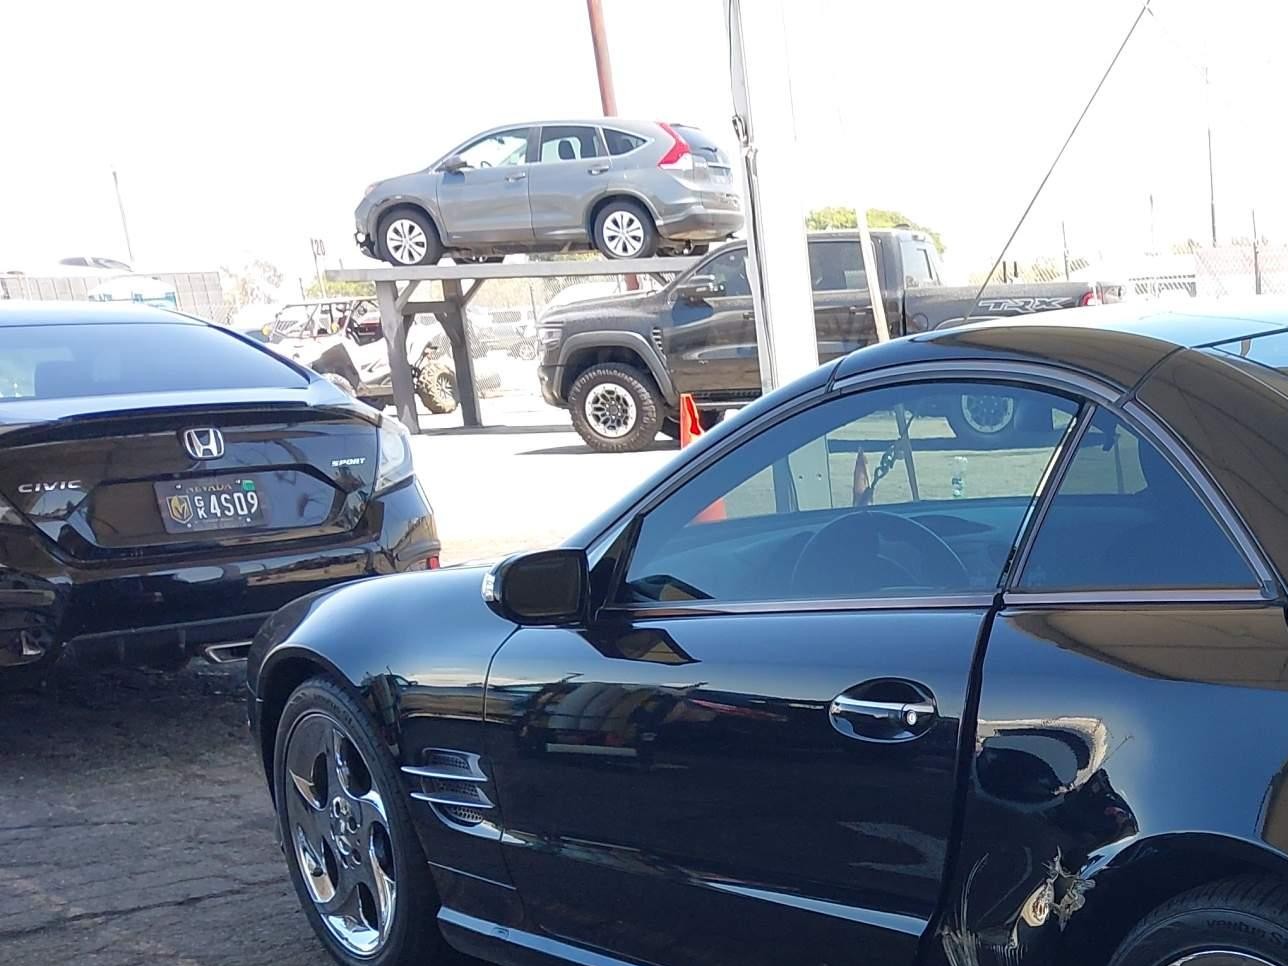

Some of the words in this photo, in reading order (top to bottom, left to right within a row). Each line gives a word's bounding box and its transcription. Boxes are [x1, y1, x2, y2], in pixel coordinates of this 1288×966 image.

[979, 297, 1072, 313] TRX
[332, 458, 366, 467] SPORT
[18, 480, 81, 493] CIVIC
